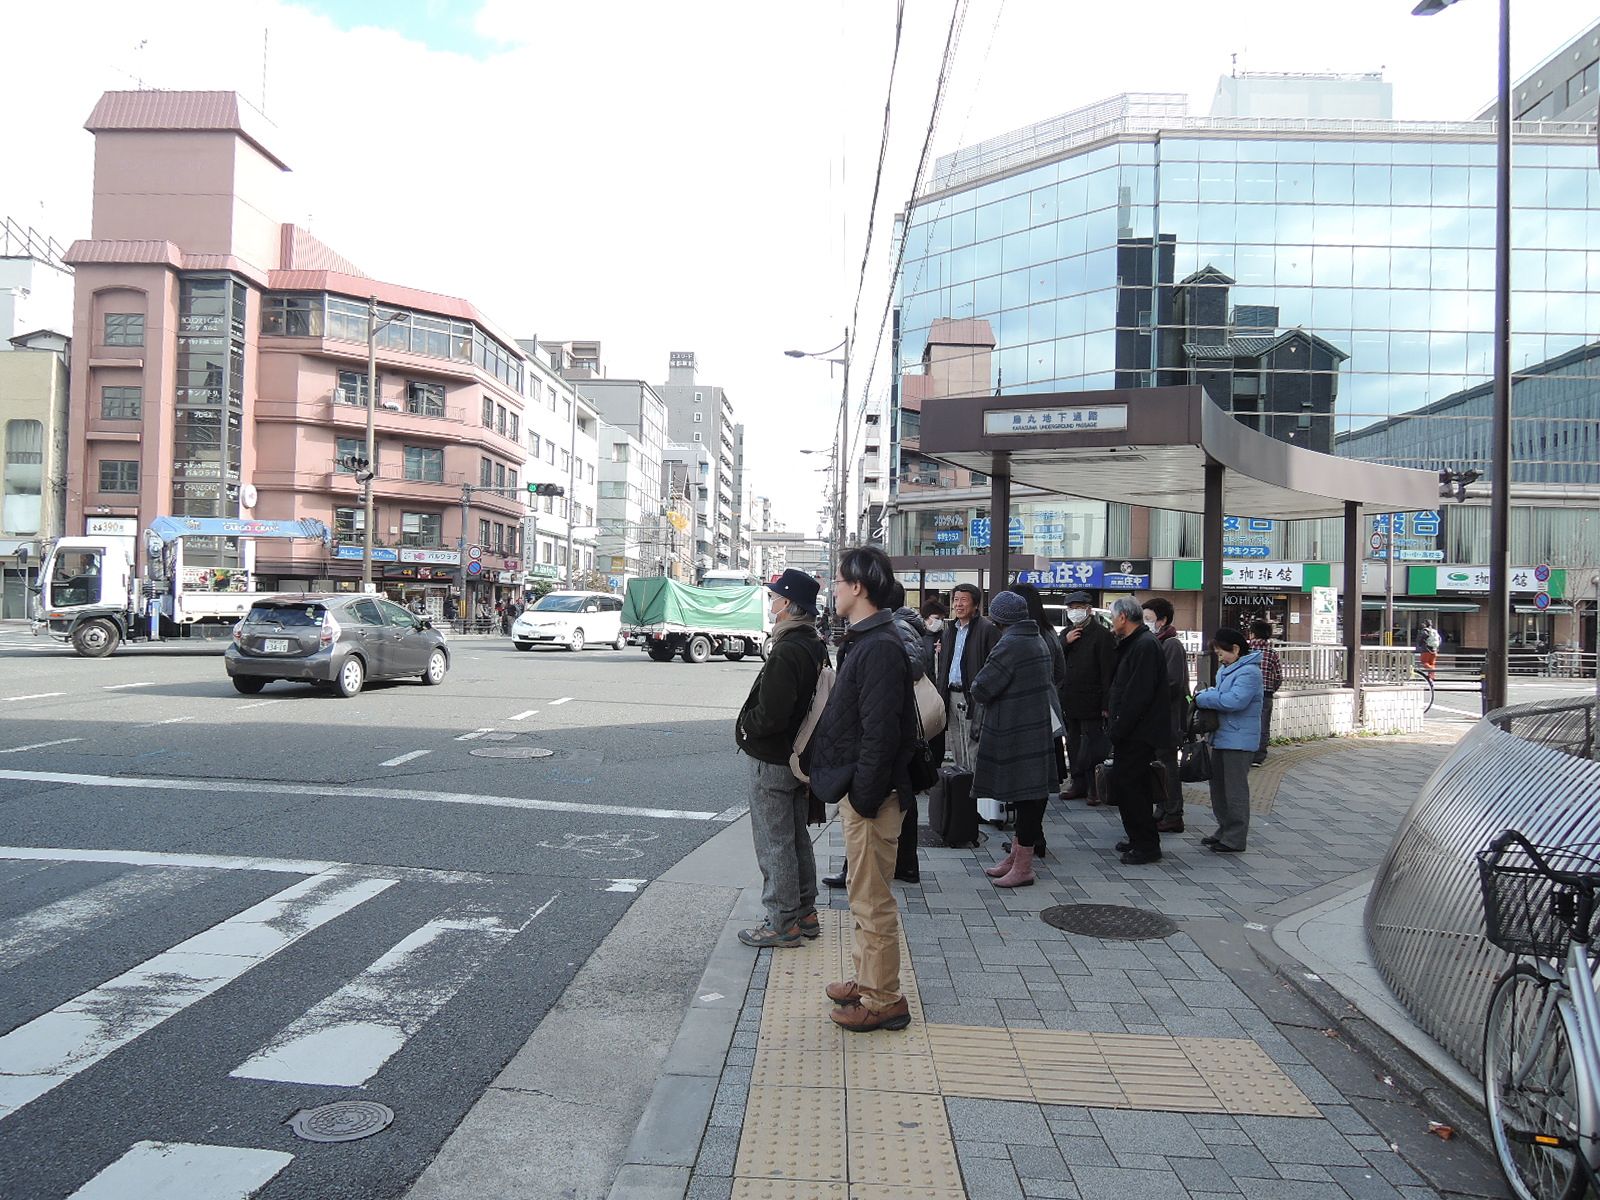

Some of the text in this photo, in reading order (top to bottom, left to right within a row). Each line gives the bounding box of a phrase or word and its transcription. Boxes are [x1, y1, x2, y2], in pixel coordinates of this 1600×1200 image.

[1027, 562, 1093, 584] 京都庄や
[1240, 566, 1292, 582] 珈琲館
